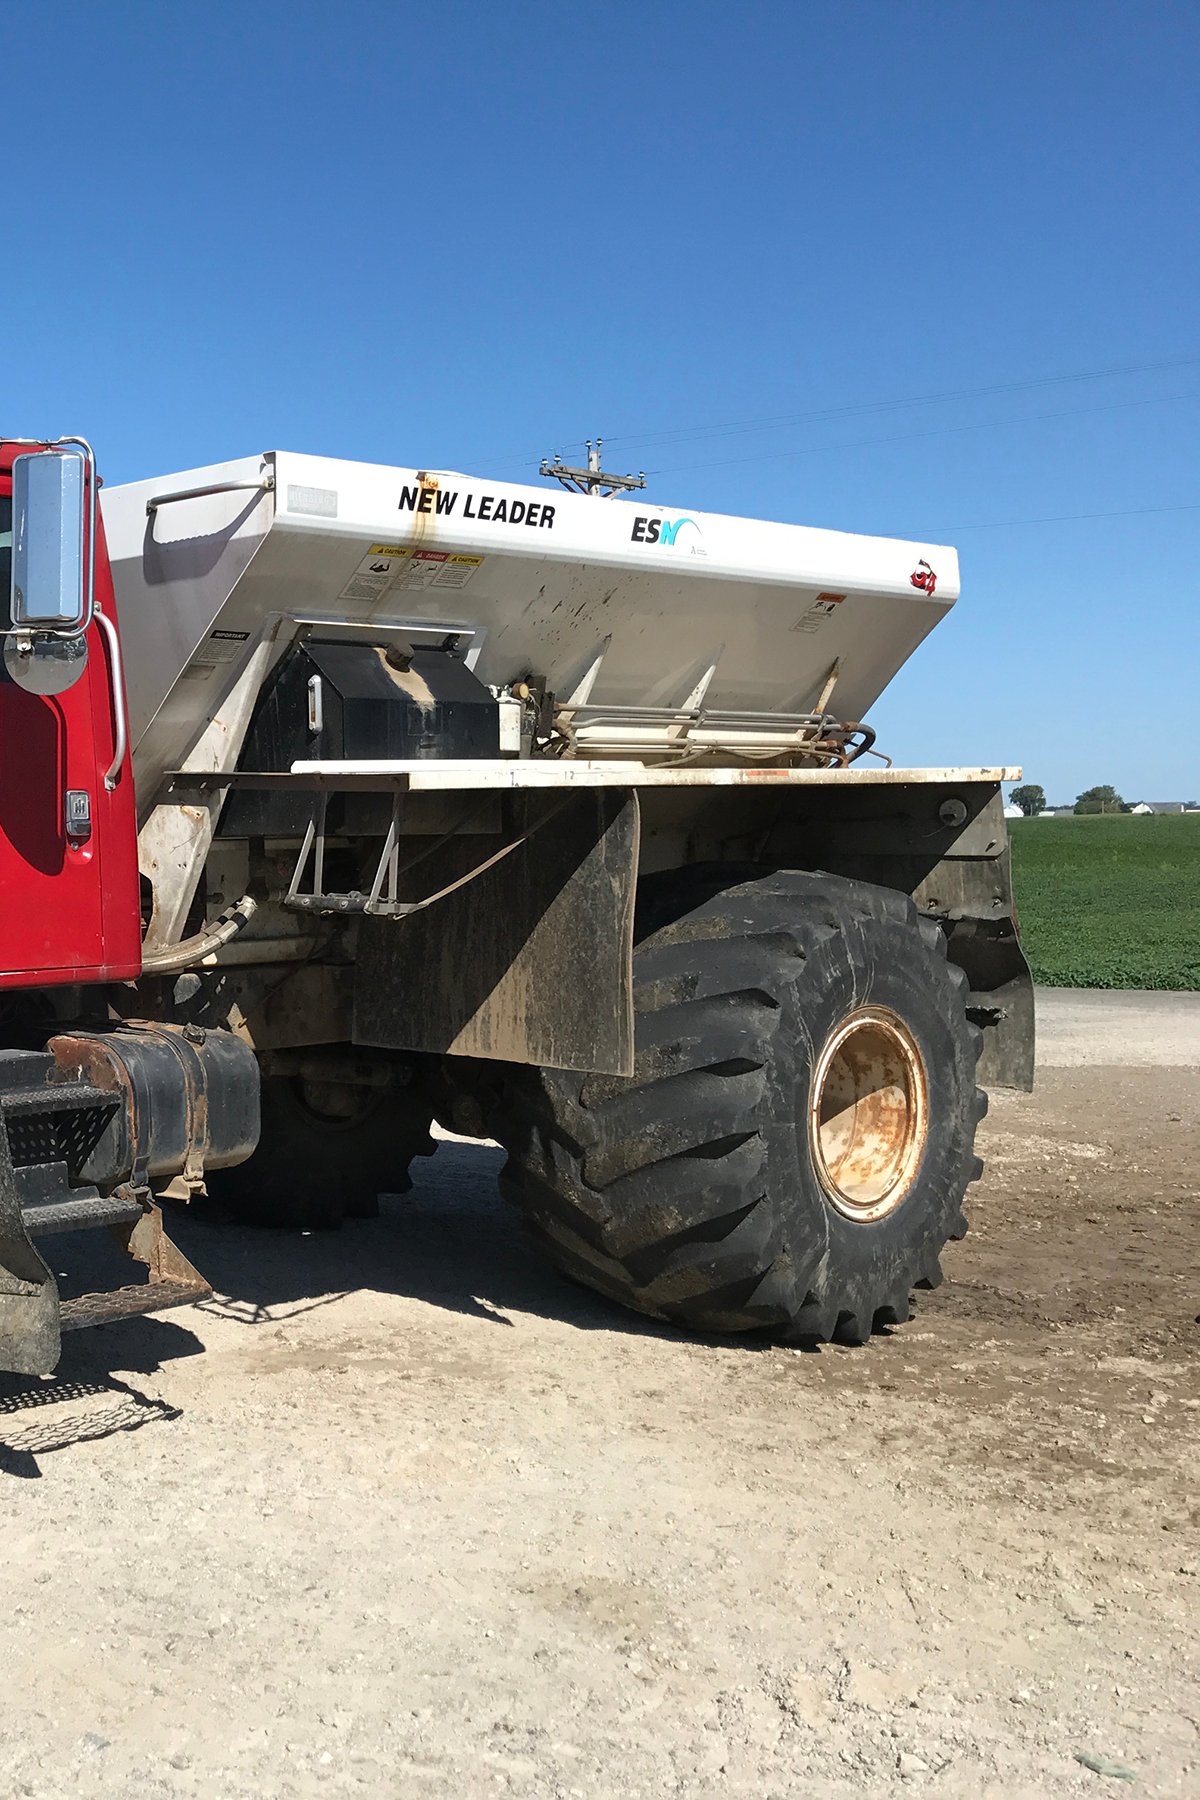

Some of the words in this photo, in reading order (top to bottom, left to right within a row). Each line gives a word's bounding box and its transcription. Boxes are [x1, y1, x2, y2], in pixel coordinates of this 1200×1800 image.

[398, 485, 458, 516] NEW
[462, 494, 557, 529] LEADER
[630, 516, 686, 546] ESN
[383, 548, 407, 556] CAUTION
[457, 556, 481, 564] CAUTION
[214, 632, 246, 640] IMPORTANT
